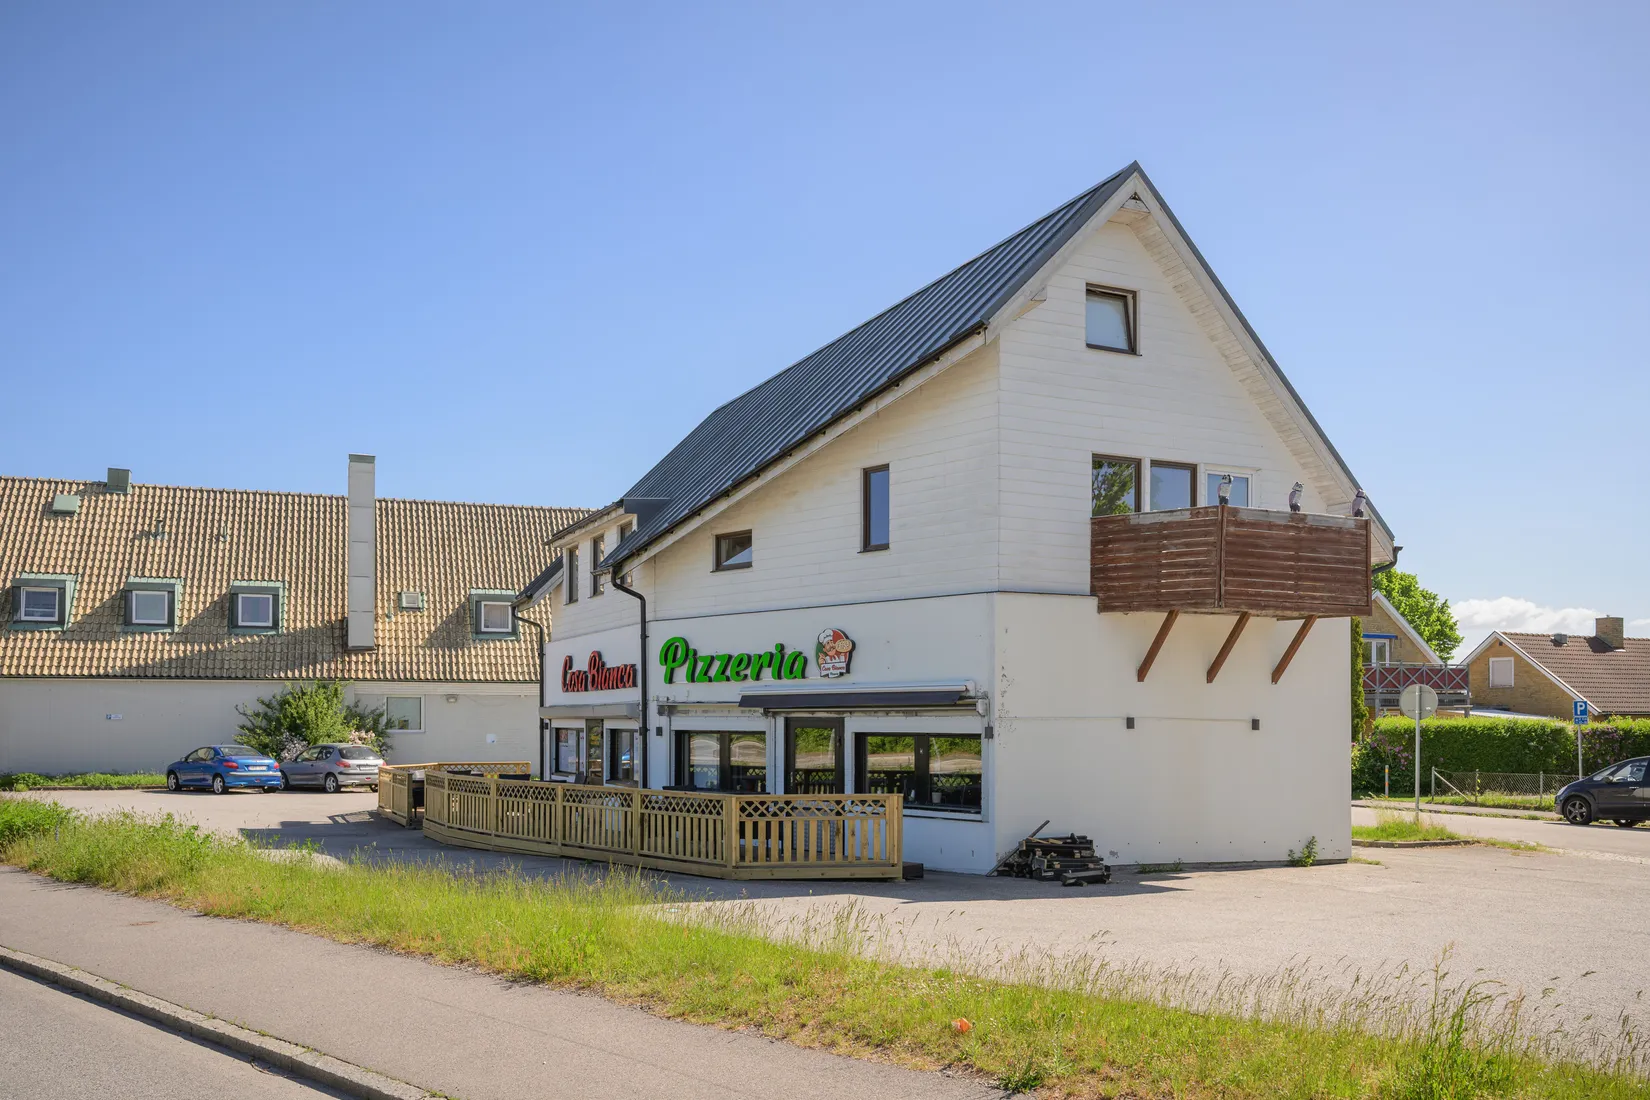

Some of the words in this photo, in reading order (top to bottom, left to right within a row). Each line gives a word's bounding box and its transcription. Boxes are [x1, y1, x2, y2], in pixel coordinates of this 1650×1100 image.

[561, 655, 587, 692] Casa
[588, 650, 637, 690] Bianca
[659, 636, 806, 684] Pizzeria
[1576, 702, 1585, 715] P
